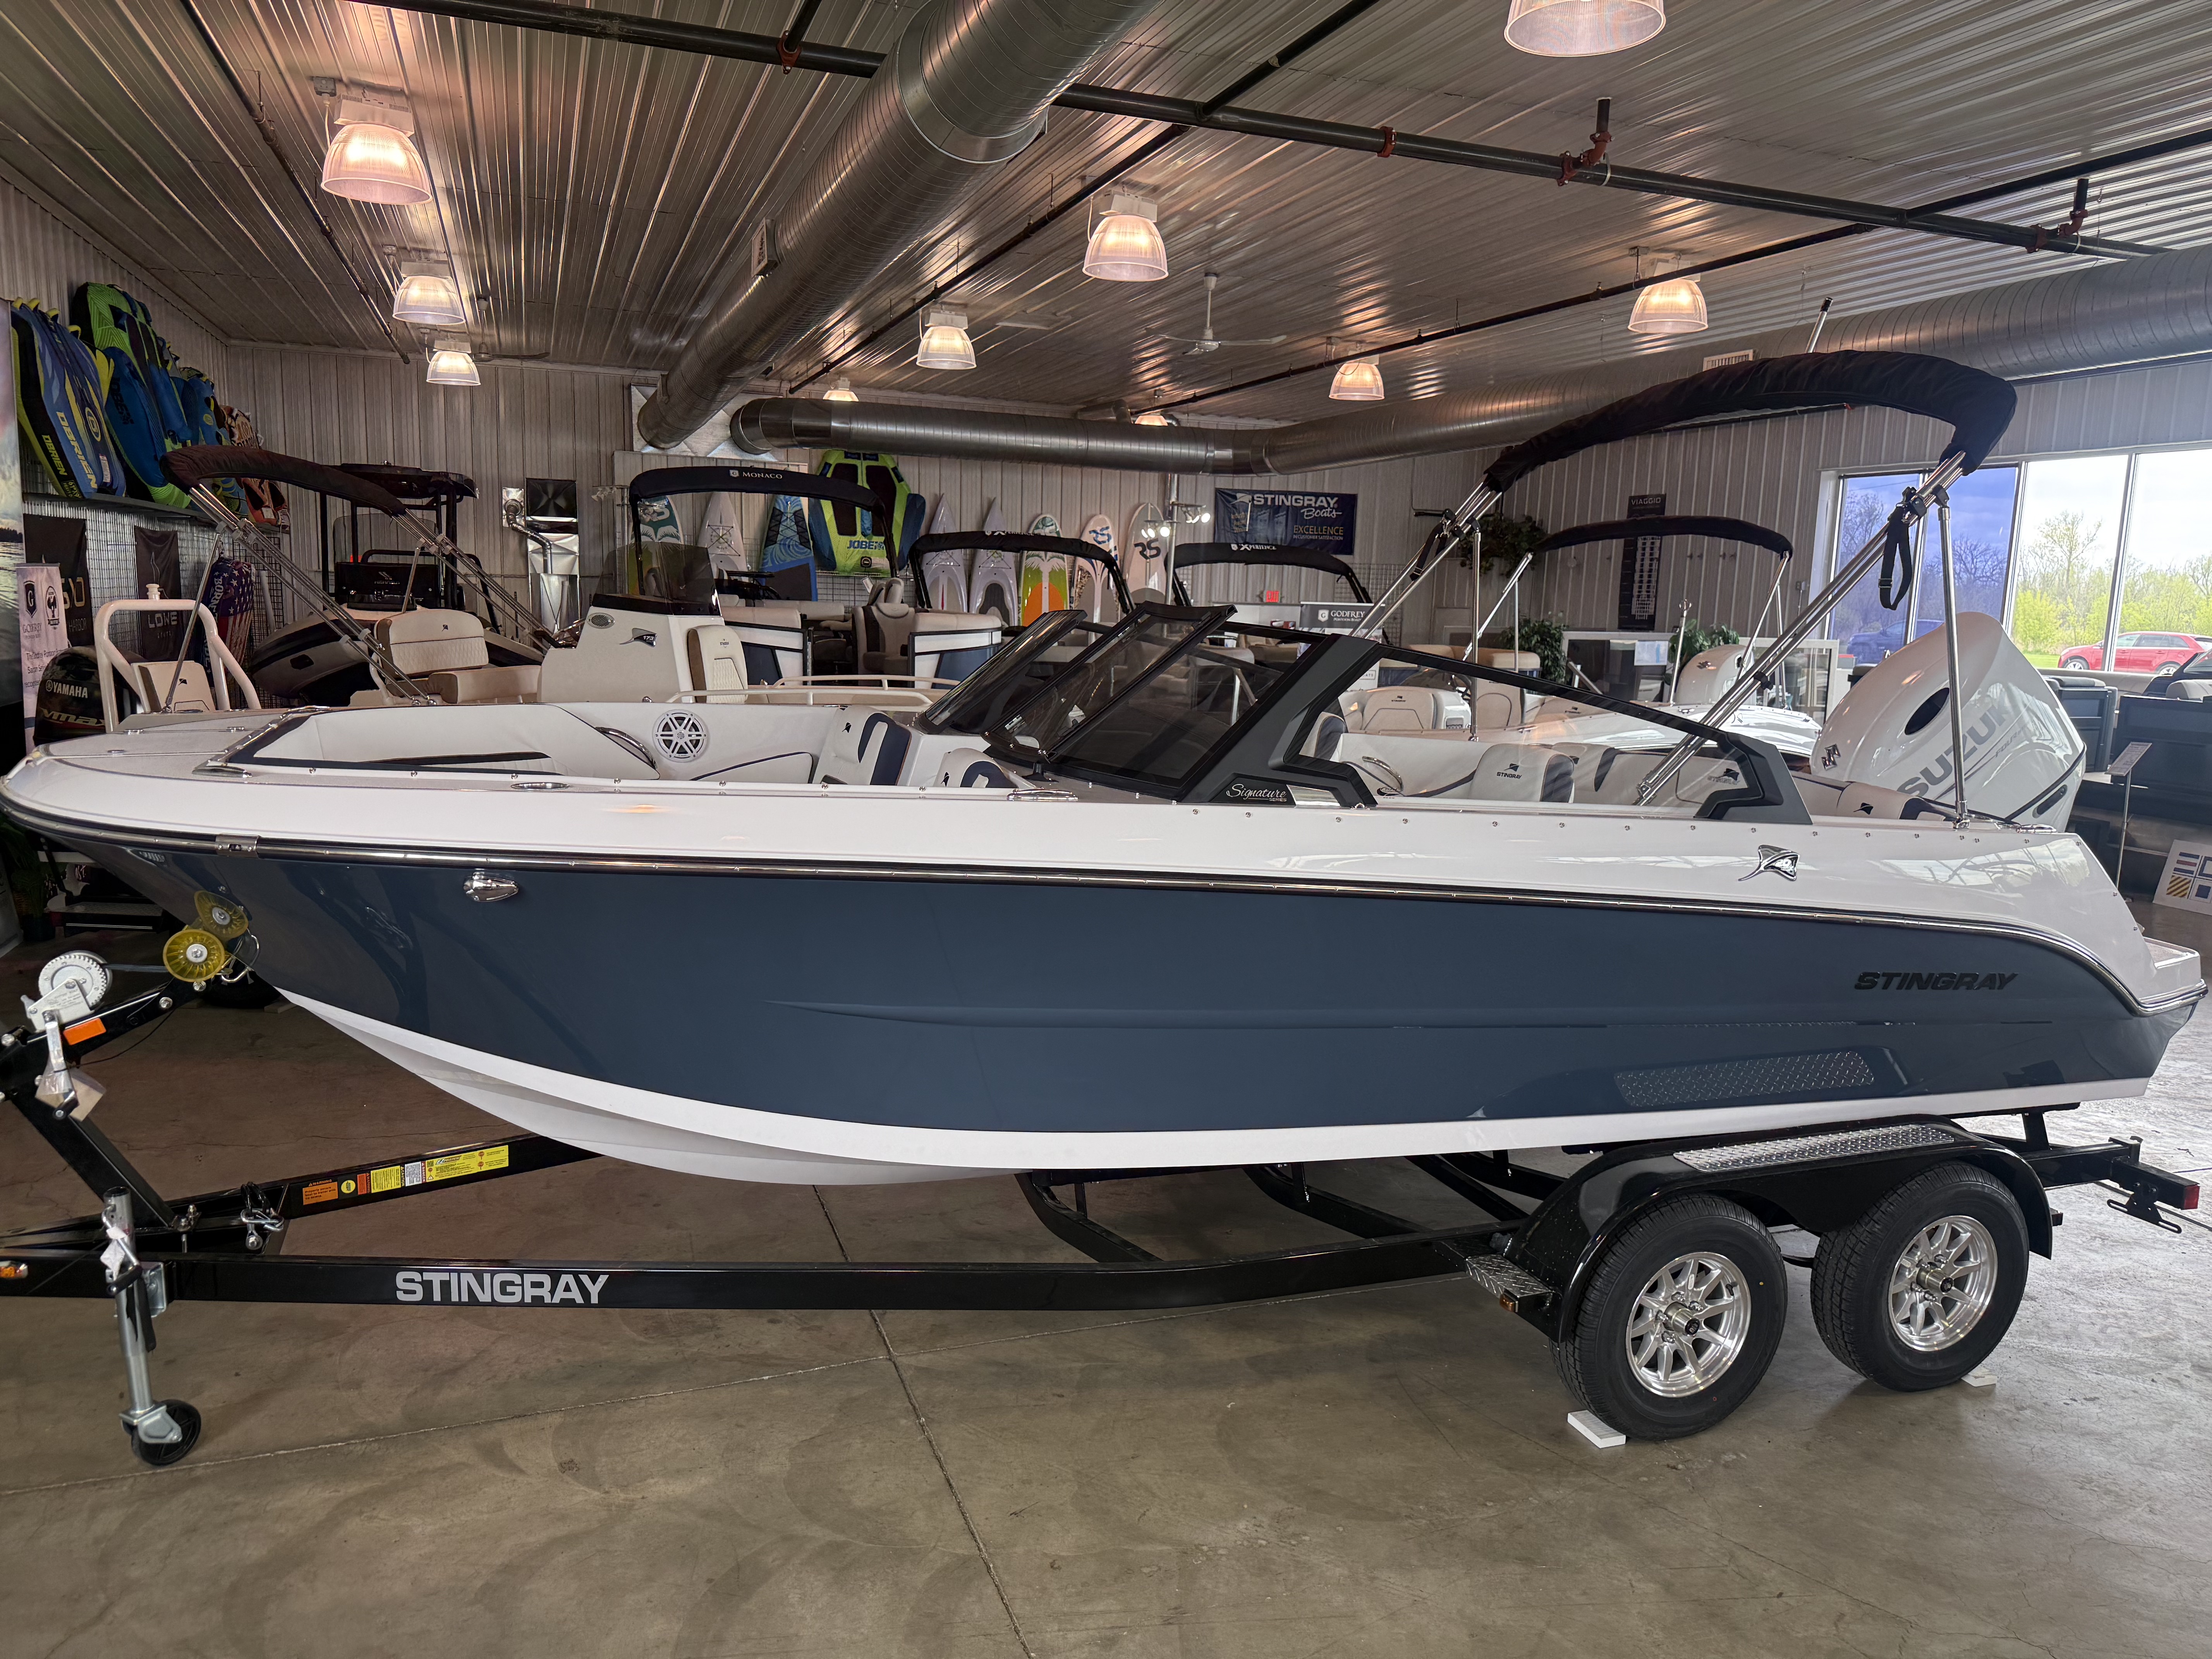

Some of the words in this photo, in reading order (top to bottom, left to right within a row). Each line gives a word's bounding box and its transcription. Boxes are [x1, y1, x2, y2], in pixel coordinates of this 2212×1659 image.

[1254, 494, 1338, 508] STINGRAY
[1300, 507, 1342, 519] Boats
[1293, 525, 1344, 535] EXCELLENCE
[847, 540, 875, 550] JOBE
[1331, 610, 1365, 618] GODFREY
[53, 682, 88, 699] YAMAHA
[1226, 784, 1287, 800] Signature
[1854, 972, 2019, 990] STINGRAY
[396, 1271, 609, 1304] STINGRAY
